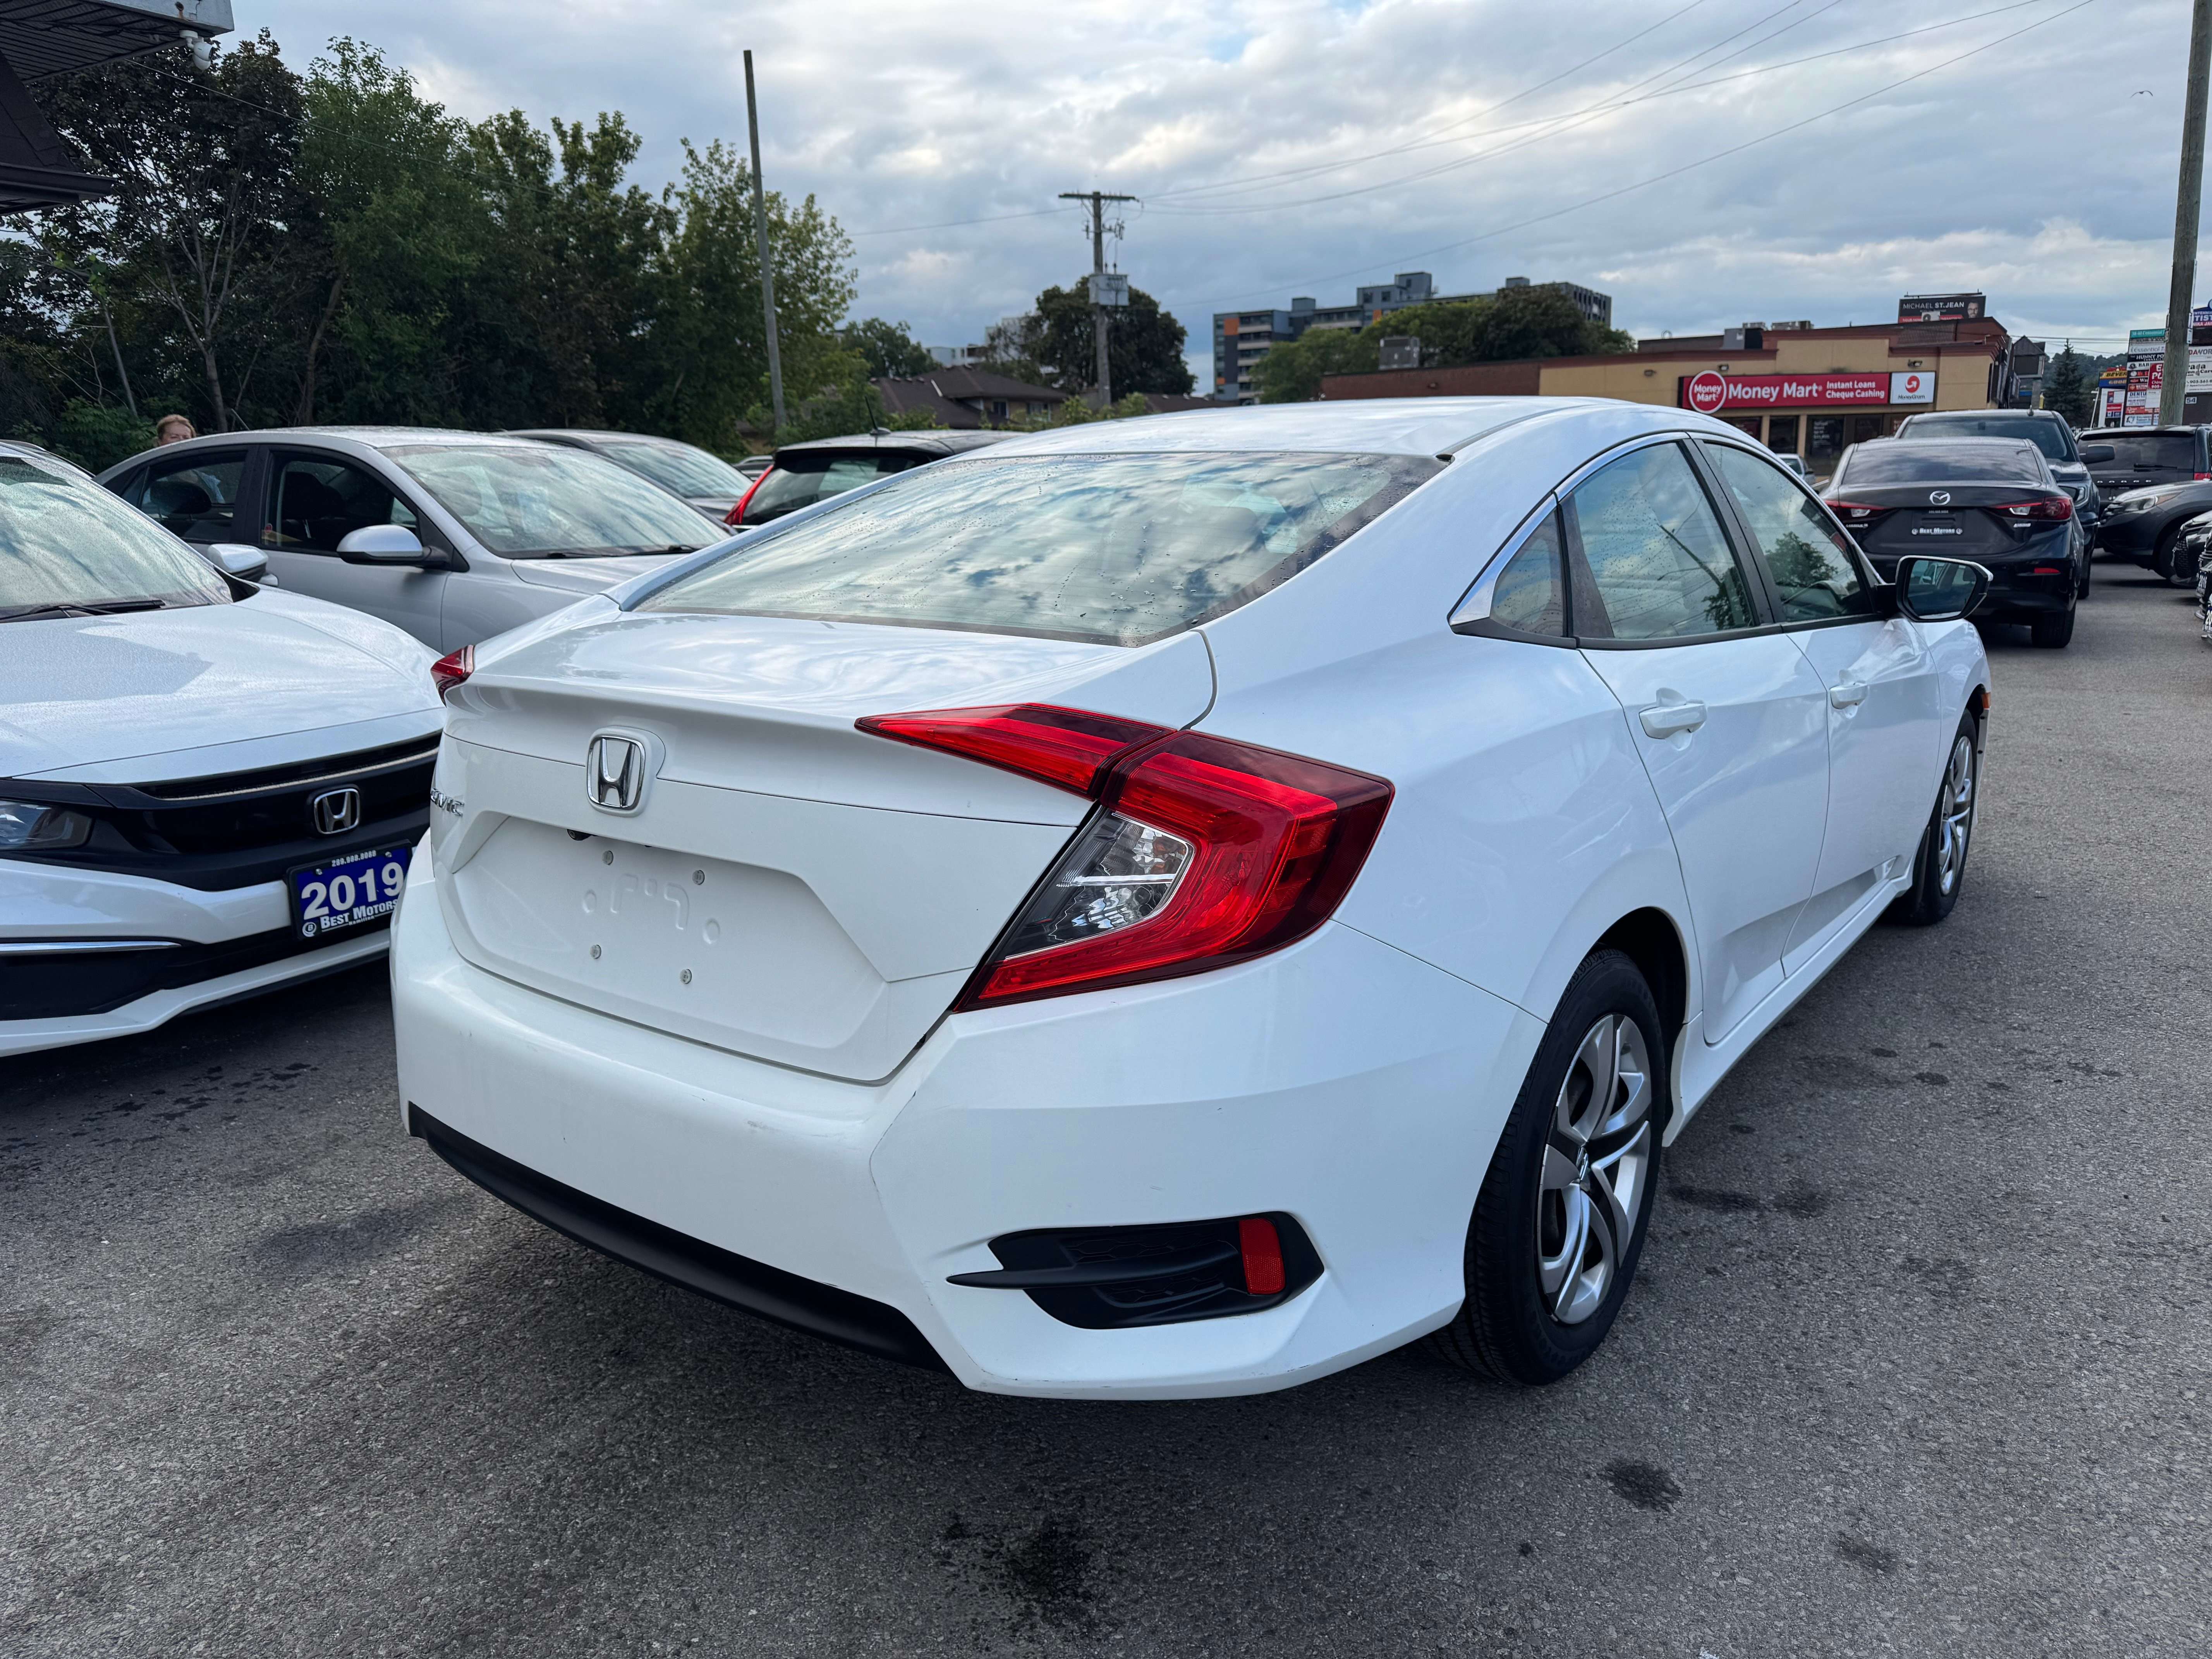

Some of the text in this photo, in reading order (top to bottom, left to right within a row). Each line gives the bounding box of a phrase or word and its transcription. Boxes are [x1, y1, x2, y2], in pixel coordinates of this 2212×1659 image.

[1694, 384, 1722, 394] Money
[1826, 380, 1876, 389] Instant Loans
[1697, 392, 1717, 402] Mart
[1728, 381, 1818, 402] Money Mart
[1826, 389, 1885, 400] Cheque Cashing
[301, 862, 404, 920] 2019
[320, 898, 398, 929] BEST MOTORS
